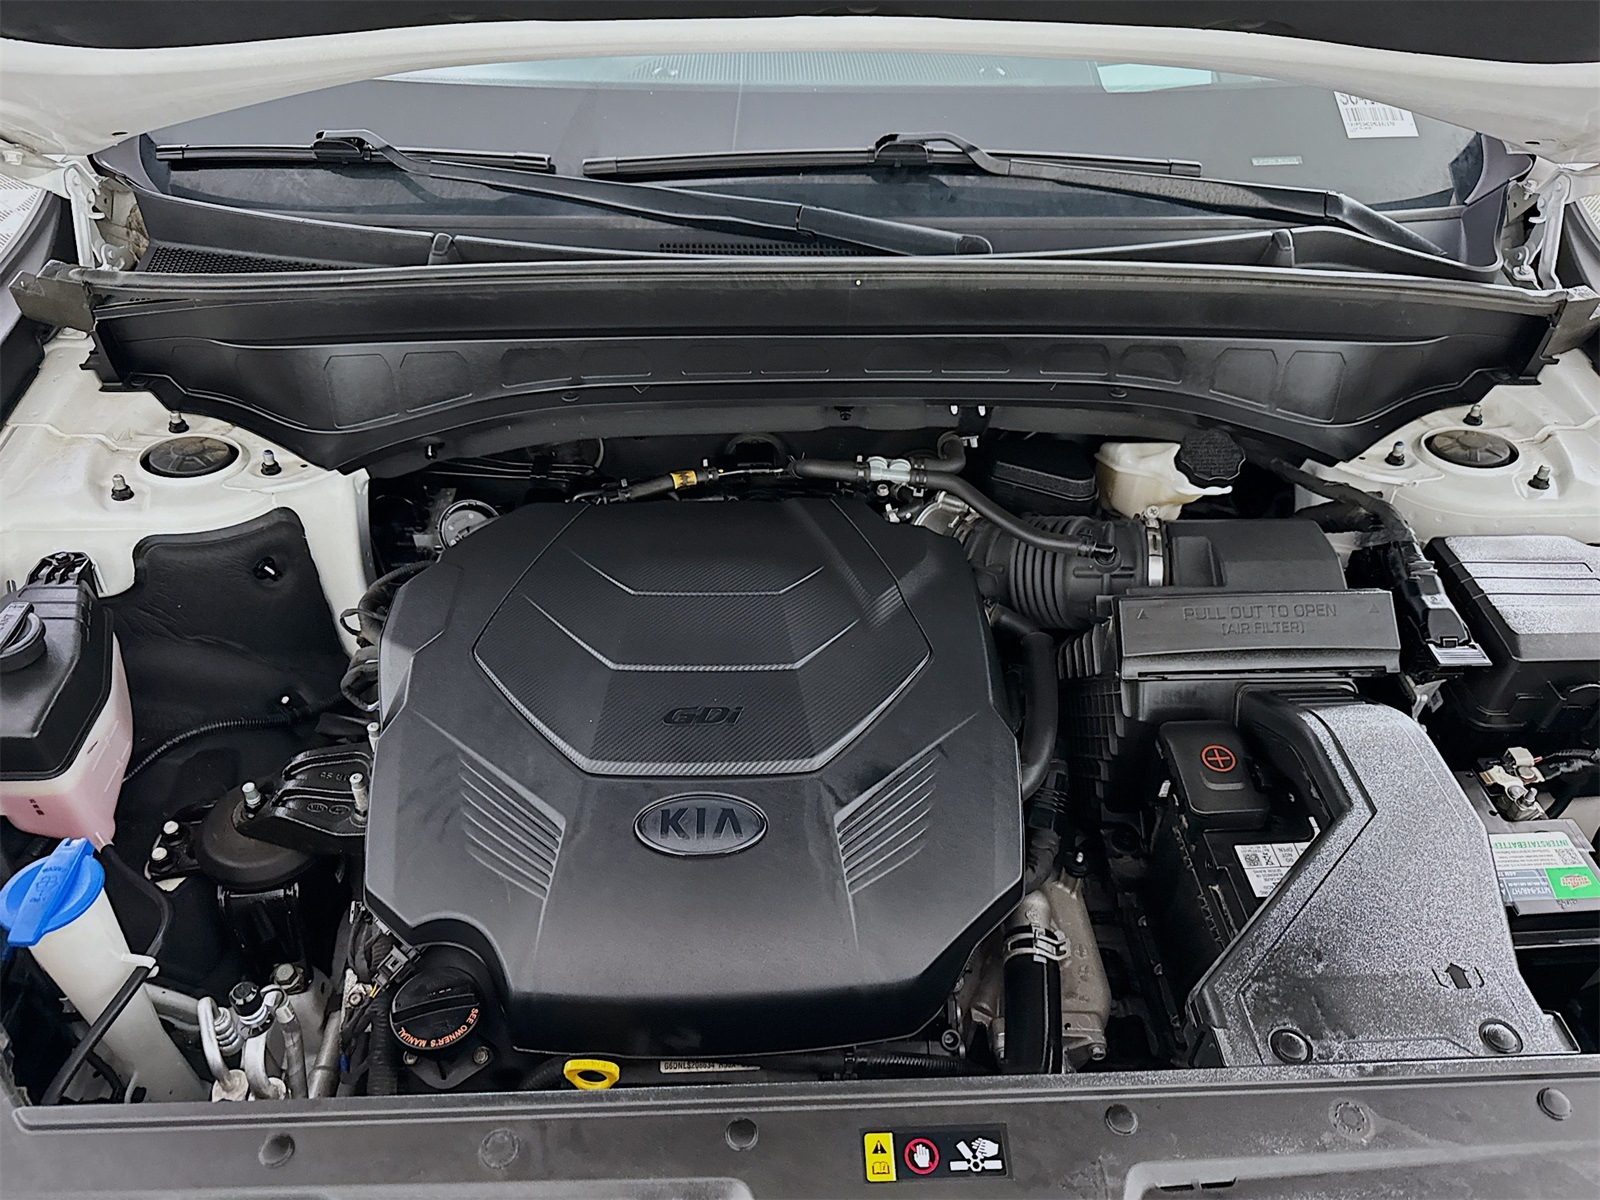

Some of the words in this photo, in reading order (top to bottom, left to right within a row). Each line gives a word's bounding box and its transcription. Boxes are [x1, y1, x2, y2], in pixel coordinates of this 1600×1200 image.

[1183, 605, 1226, 621] PULL
[1230, 605, 1262, 620] OUT
[1265, 604, 1289, 619] TO
[1294, 603, 1337, 618] OPEN
[662, 706, 745, 726] GDi
[659, 807, 745, 840] KIA
[465, 1007, 479, 1025] SEE
[398, 1026, 428, 1048] MANUAL
[429, 1024, 468, 1048] OWNER'S
